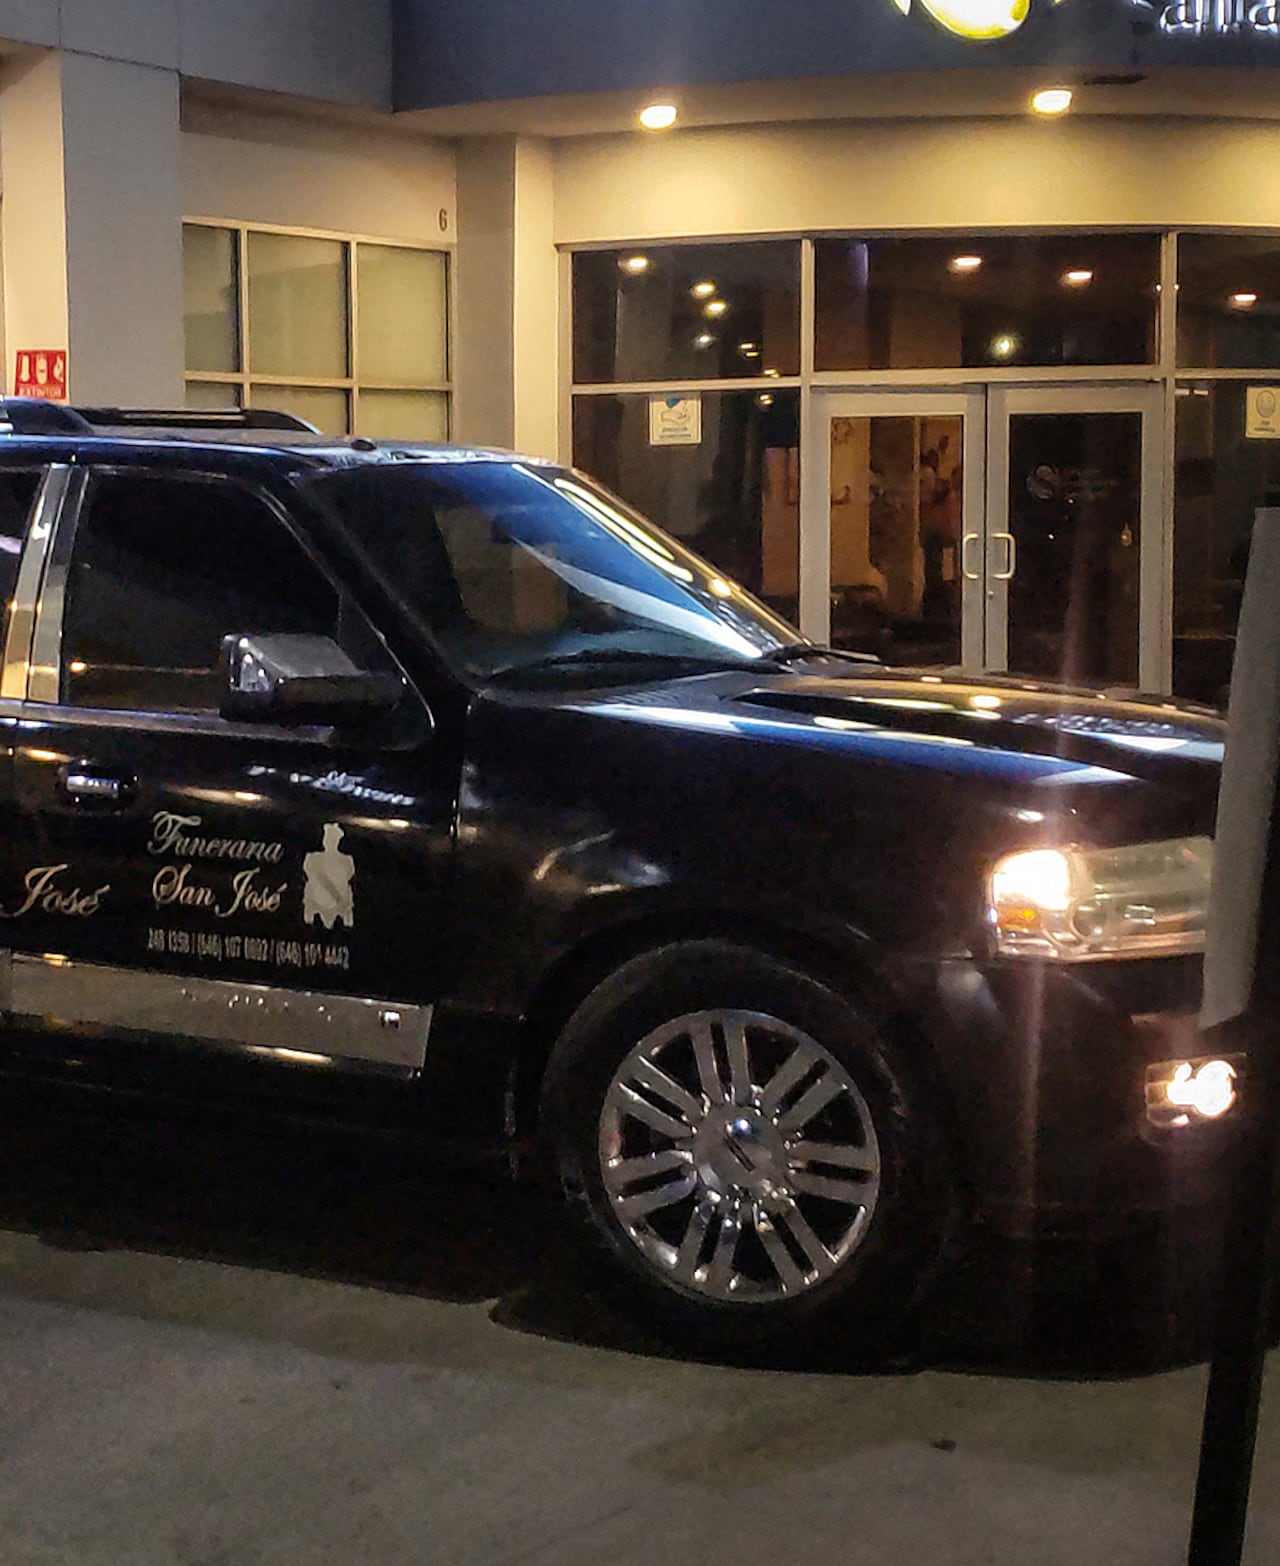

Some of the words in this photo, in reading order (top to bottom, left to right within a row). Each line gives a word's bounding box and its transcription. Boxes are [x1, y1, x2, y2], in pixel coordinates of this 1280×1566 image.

[438, 207, 448, 232] 6
[147, 810, 284, 863] Funeraria
[153, 863, 215, 906] San
[215, 867, 288, 918] José
